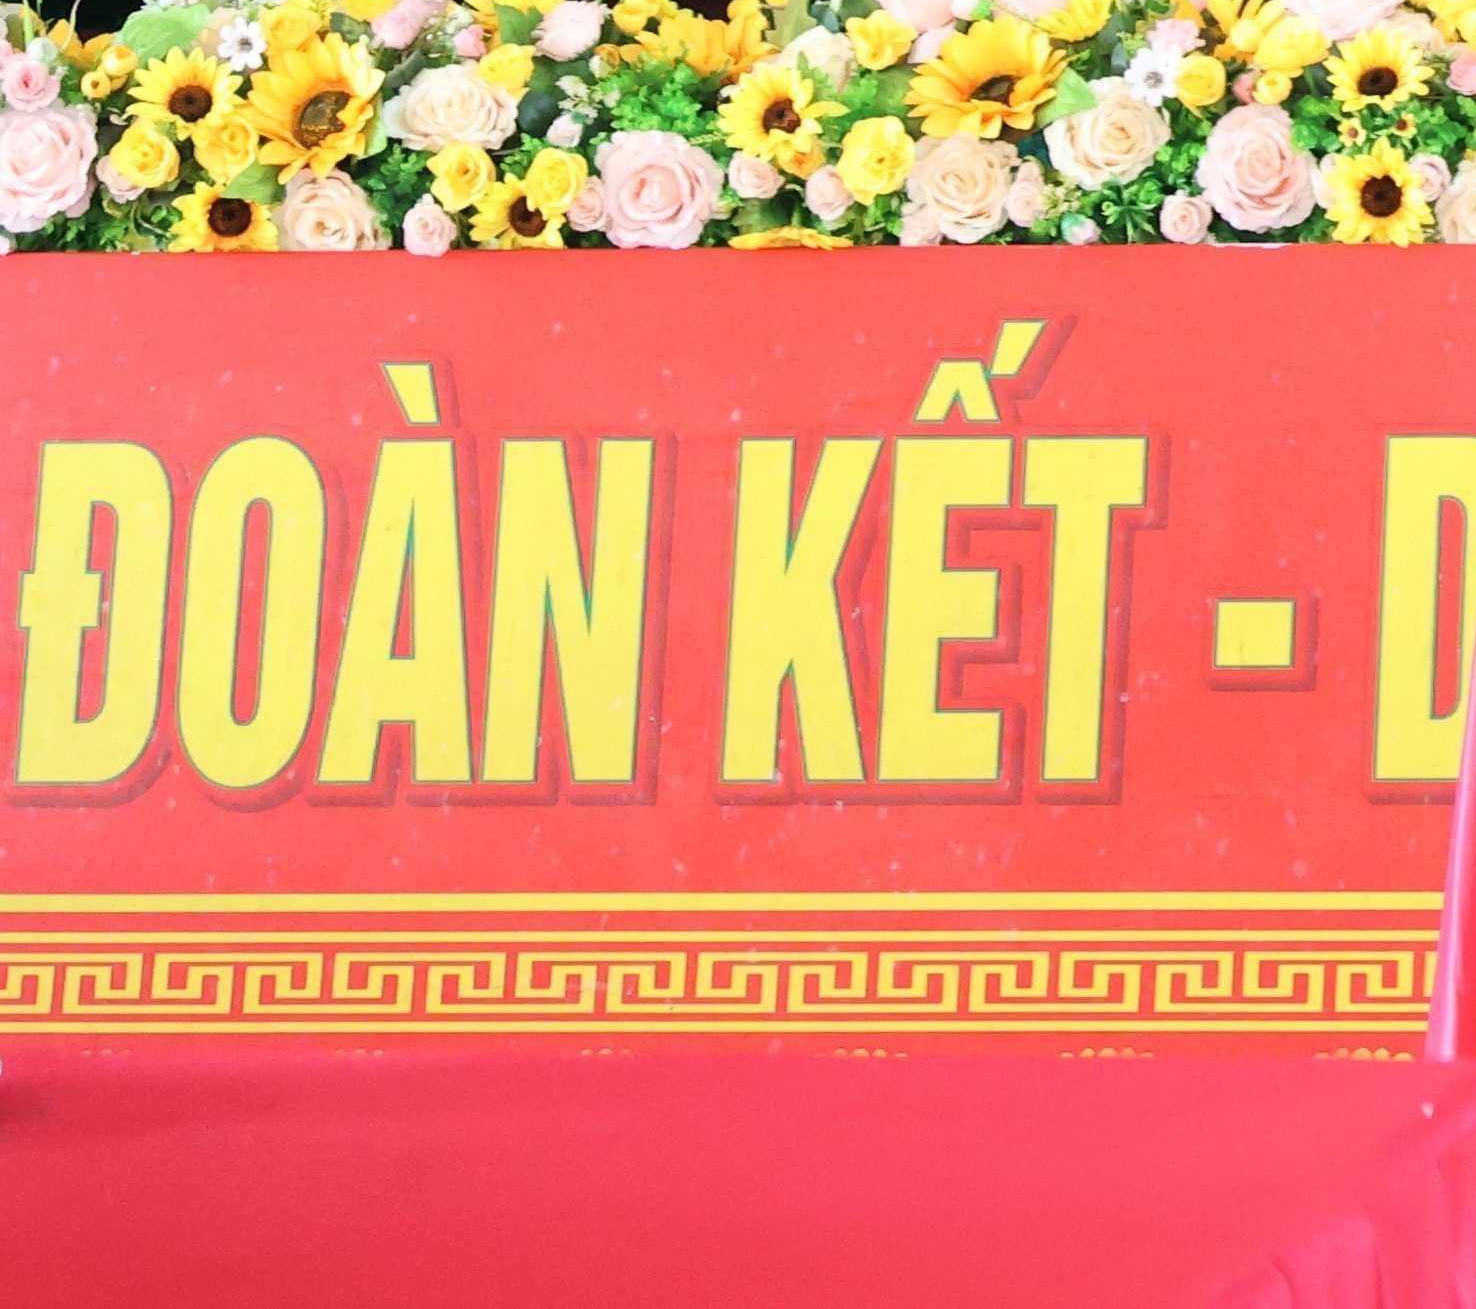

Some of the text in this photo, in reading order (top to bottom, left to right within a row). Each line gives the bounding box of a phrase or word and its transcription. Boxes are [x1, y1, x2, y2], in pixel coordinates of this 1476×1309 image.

[11, 360, 656, 789] ĐOÀN
[717, 316, 1148, 787] KẾT
[1214, 597, 1295, 669] -
